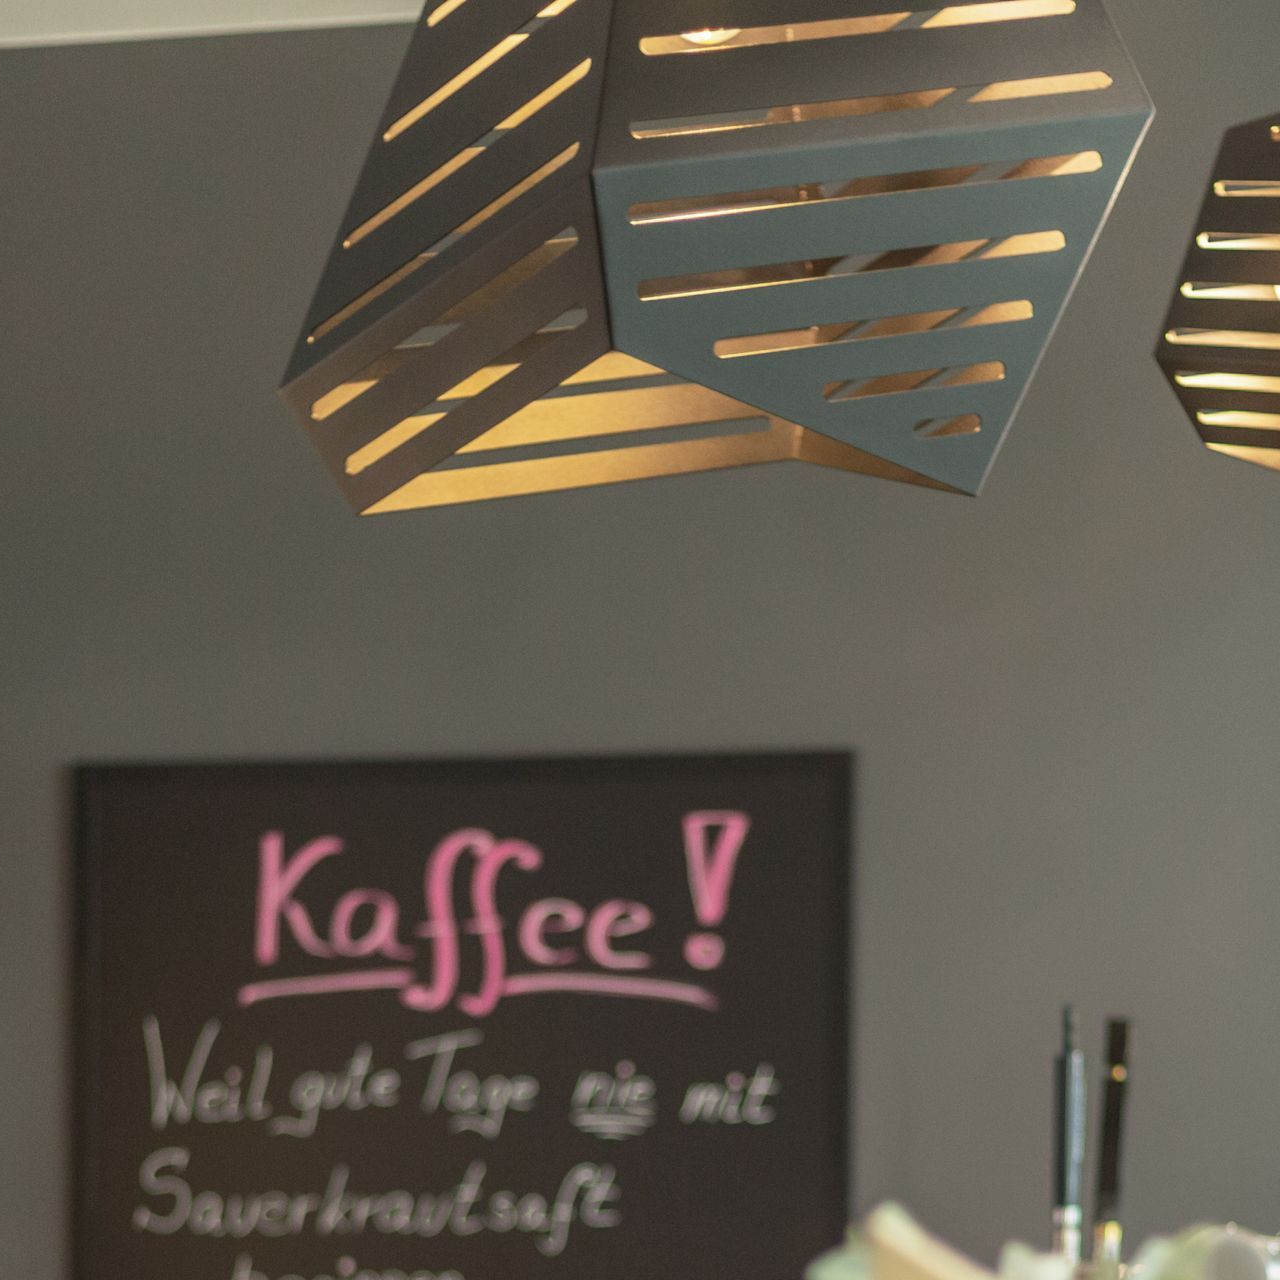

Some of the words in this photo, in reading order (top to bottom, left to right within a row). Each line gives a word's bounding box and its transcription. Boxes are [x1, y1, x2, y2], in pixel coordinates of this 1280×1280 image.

[254, 809, 751, 1018] Kaffee!
[142, 1015, 273, 1131] Weil
[269, 1044, 402, 1138] gute
[404, 1027, 540, 1139] Tage
[569, 1059, 657, 1118] nie
[679, 1062, 780, 1125] mit
[132, 1146, 621, 1257] Sauerkrautsaft
